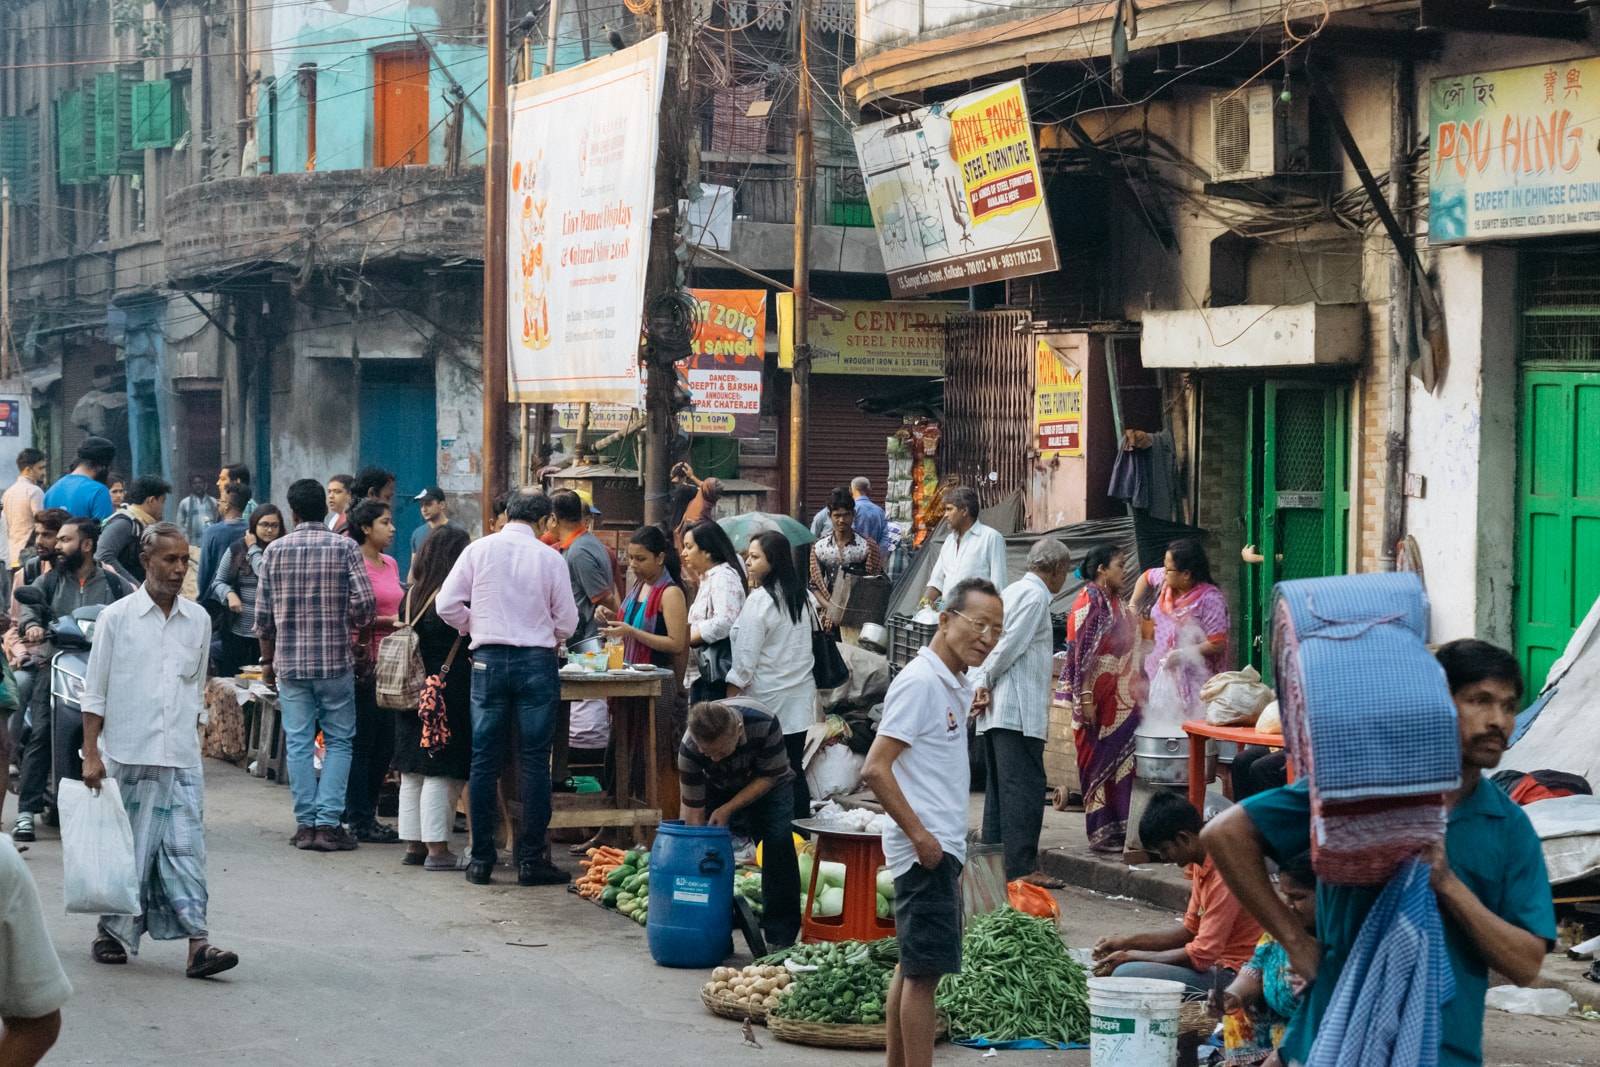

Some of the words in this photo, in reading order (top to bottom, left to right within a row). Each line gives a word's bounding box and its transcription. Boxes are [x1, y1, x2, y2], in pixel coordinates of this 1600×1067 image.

[953, 113, 988, 158] ROYAL
[985, 96, 1024, 144] TOUCH
[1435, 117, 1491, 180] POU
[1501, 109, 1583, 174] HING
[963, 155, 987, 183] STEEL
[986, 140, 1030, 174] FURNITURE
[1474, 189, 1509, 212] EXPERT
[1512, 187, 1523, 209] IN
[1525, 184, 1566, 207] CHINESE
[713, 303, 757, 338] 2018
[853, 310, 945, 333] CENTRA
[704, 339, 757, 357] SANGH
[846, 335, 886, 347] STEEL
[844, 357, 875, 366] WROUGHT
[876, 357, 893, 366] IRON
[912, 359, 929, 367] STEEL
[690, 381, 717, 391] DEEPTI
[719, 382, 726, 391] &
[727, 383, 758, 391] BARSHA
[713, 400, 758, 410] CHATERJEE
[1039, 392, 1053, 415] STEEL
[1053, 390, 1080, 414] FURNITURE
[707, 415, 729, 423] 10PM
